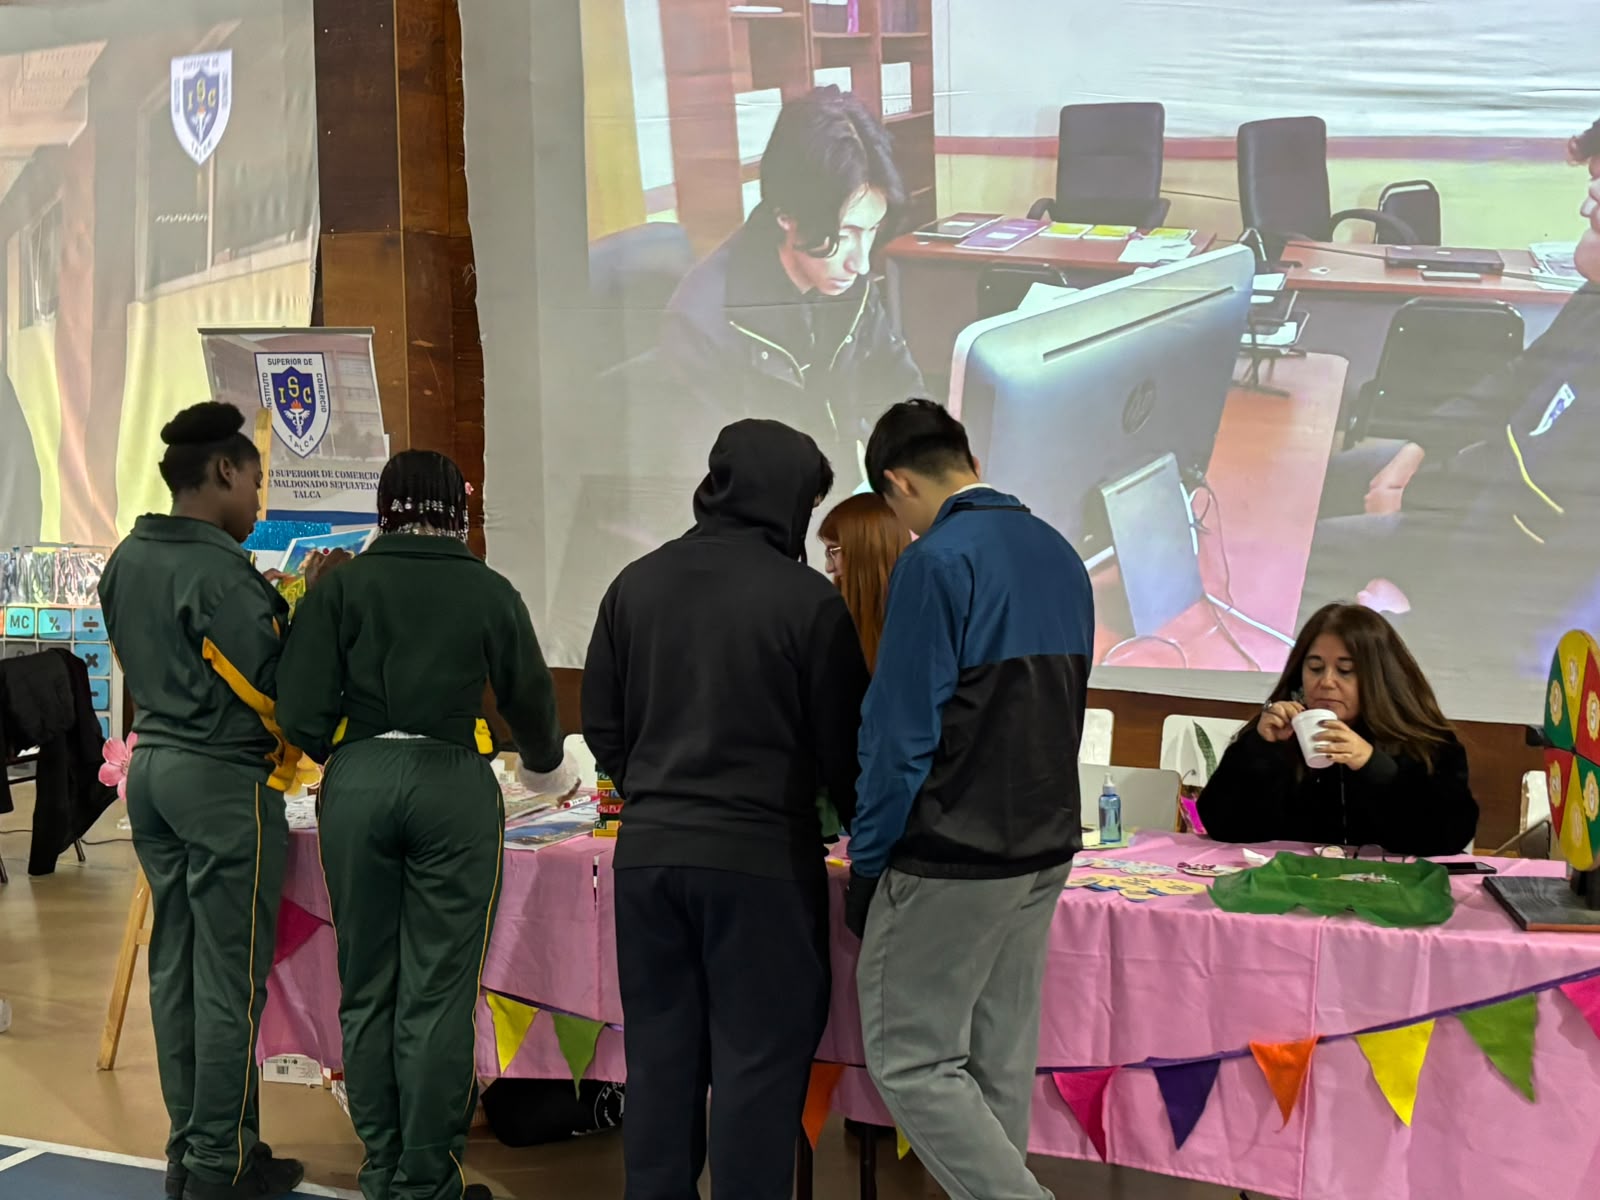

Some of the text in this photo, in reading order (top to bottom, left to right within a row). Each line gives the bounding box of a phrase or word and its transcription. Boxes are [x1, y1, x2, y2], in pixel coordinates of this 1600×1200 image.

[267, 358, 313, 366] SUPERIOR DE
[262, 372, 272, 410] NSTITUTO
[316, 372, 327, 413] COMERCIO
[288, 435, 314, 452] TALCA
[276, 469, 320, 478] SUPERIOR
[322, 470, 334, 479] DE
[334, 471, 379, 480] COMERCIO
[273, 479, 328, 488] MALDONADO
[329, 481, 378, 490] SEPULVEDA
[293, 490, 321, 499] TALCA
[9, 614, 30, 629] MC
